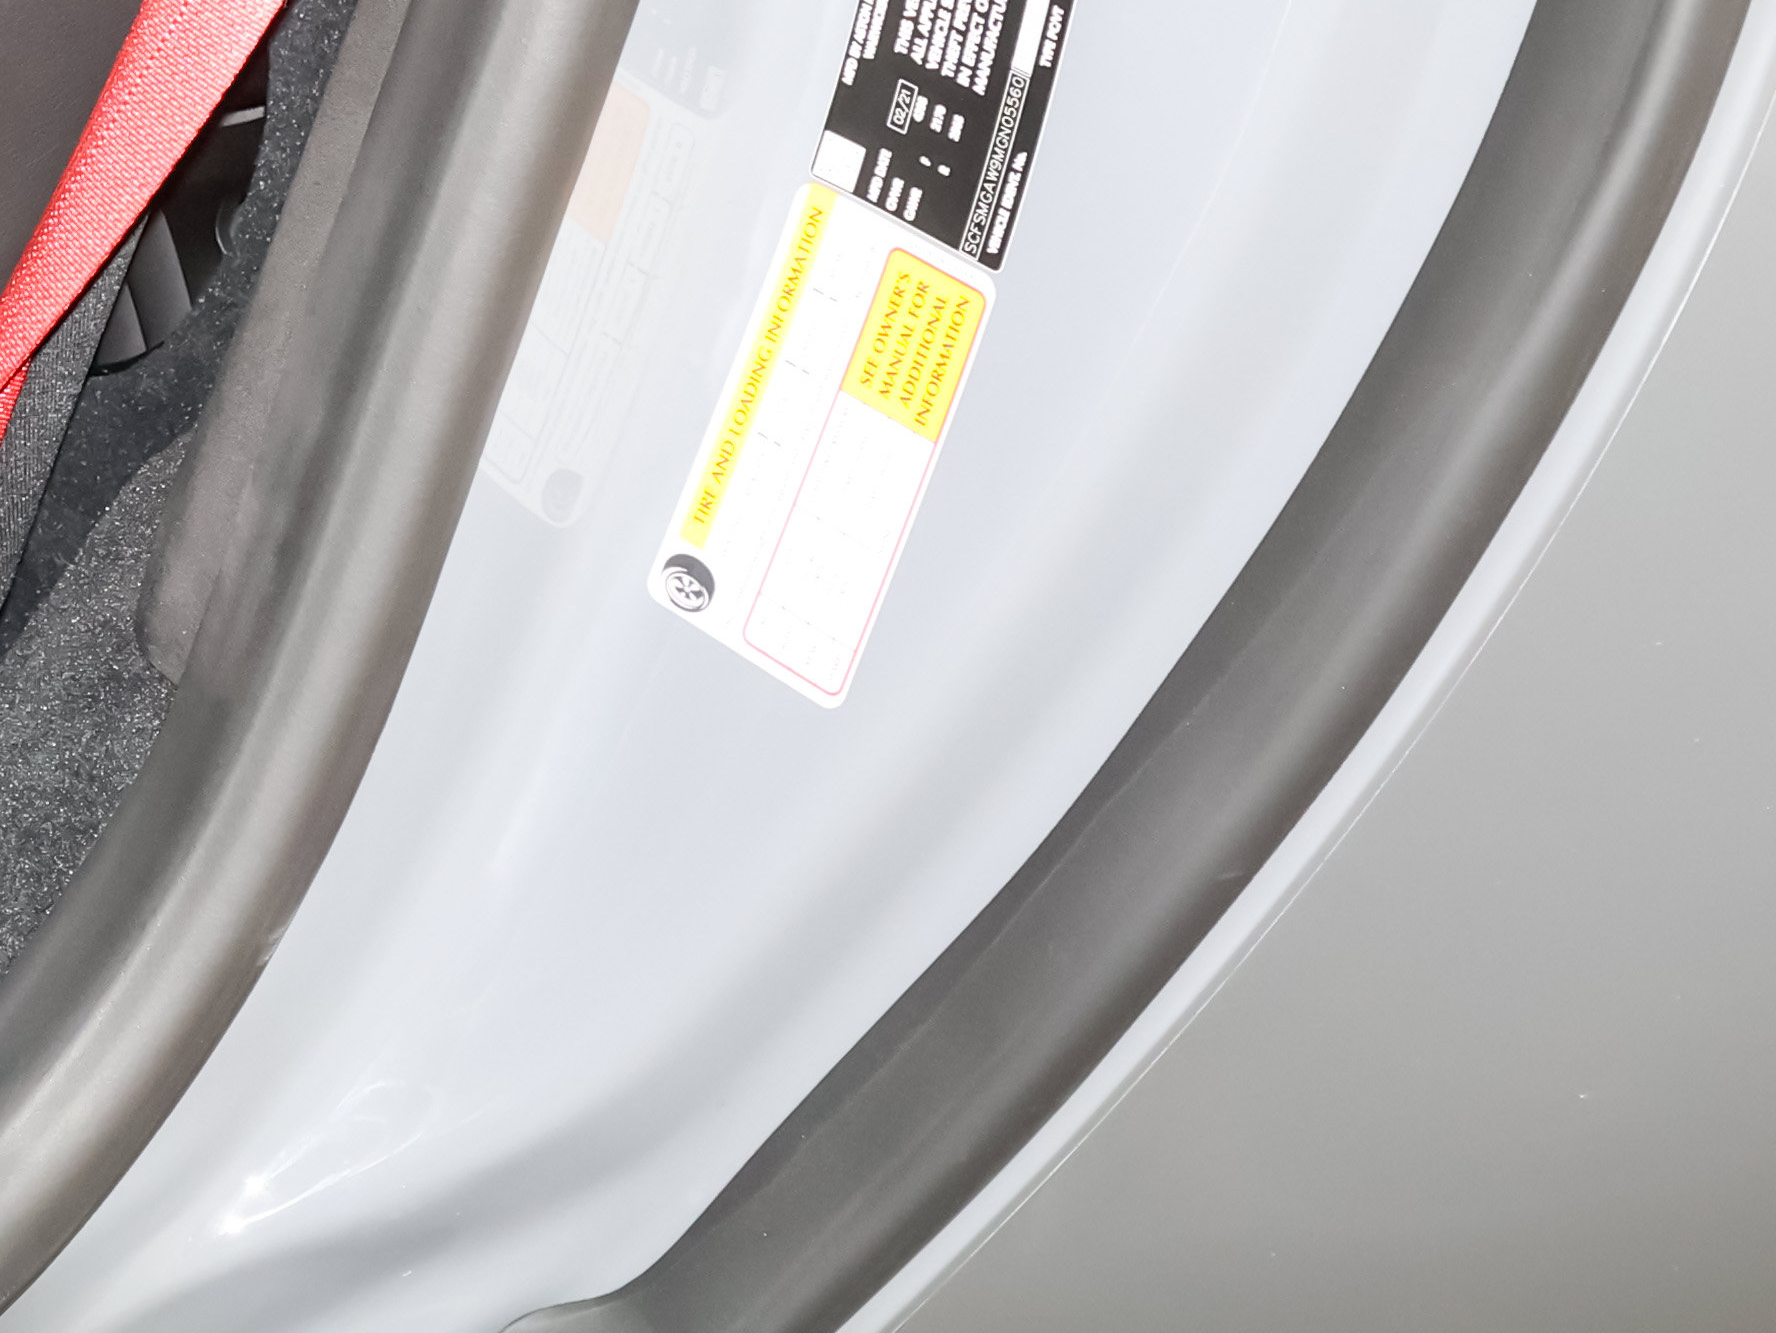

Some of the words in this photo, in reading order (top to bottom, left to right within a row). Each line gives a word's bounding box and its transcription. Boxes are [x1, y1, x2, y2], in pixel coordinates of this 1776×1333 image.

[853, 2, 872, 44] ASTON
[893, 18, 914, 54] THIS
[924, 8, 951, 69] VEHICLE
[961, 11, 985, 67] EFFECT
[909, 37, 928, 65] ALL
[940, 29, 963, 77] THEFT
[955, 65, 972, 87] IN
[892, 88, 911, 128] 02/21
[986, 207, 1010, 253] VEHICLE
[871, 269, 912, 355] OWNER'S
[709, 436, 736, 485] AND
[727, 342, 773, 437] LOADING
[763, 204, 825, 344] INFORMATION
[877, 321, 915, 400] MANUAL
[907, 279, 930, 319] FOR
[897, 293, 948, 409] ADDITIONAL
[914, 294, 970, 427] INFORMATION
